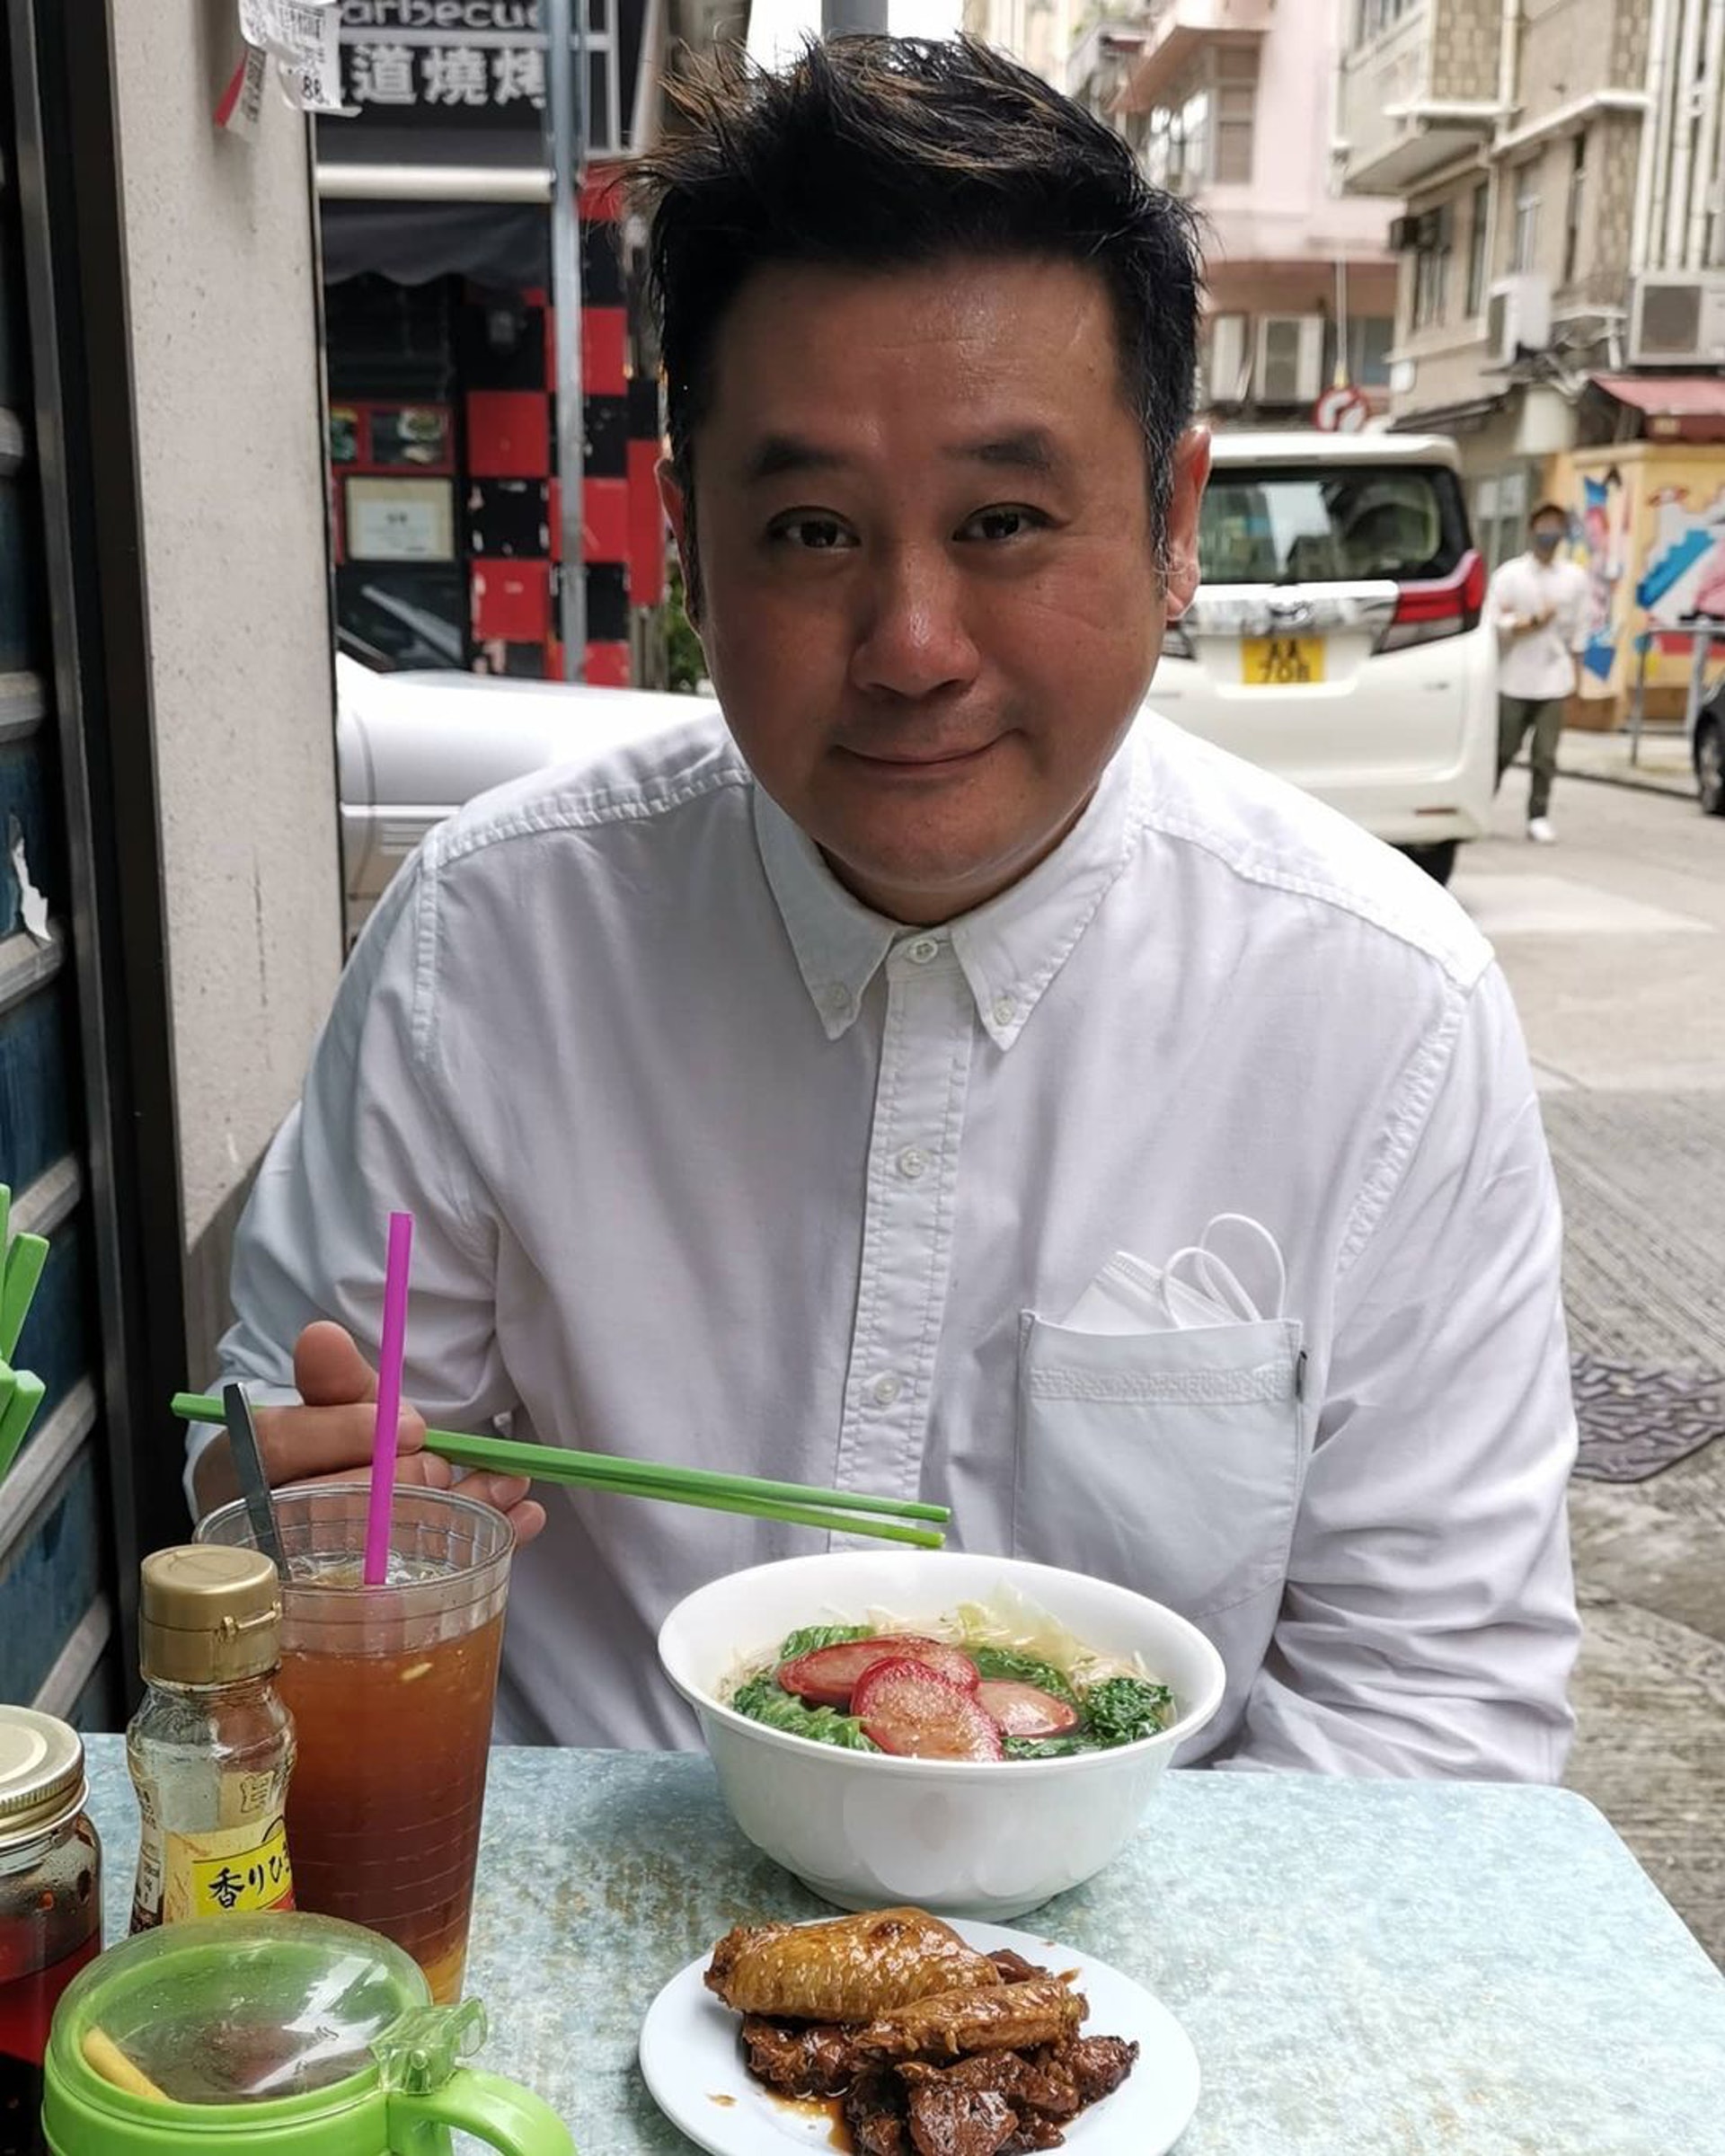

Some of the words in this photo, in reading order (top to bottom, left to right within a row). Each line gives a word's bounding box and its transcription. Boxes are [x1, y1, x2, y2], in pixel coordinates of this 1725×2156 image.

[342, 45, 546, 108] 道燒烤
[208, 1841, 290, 1909] 香りひ
